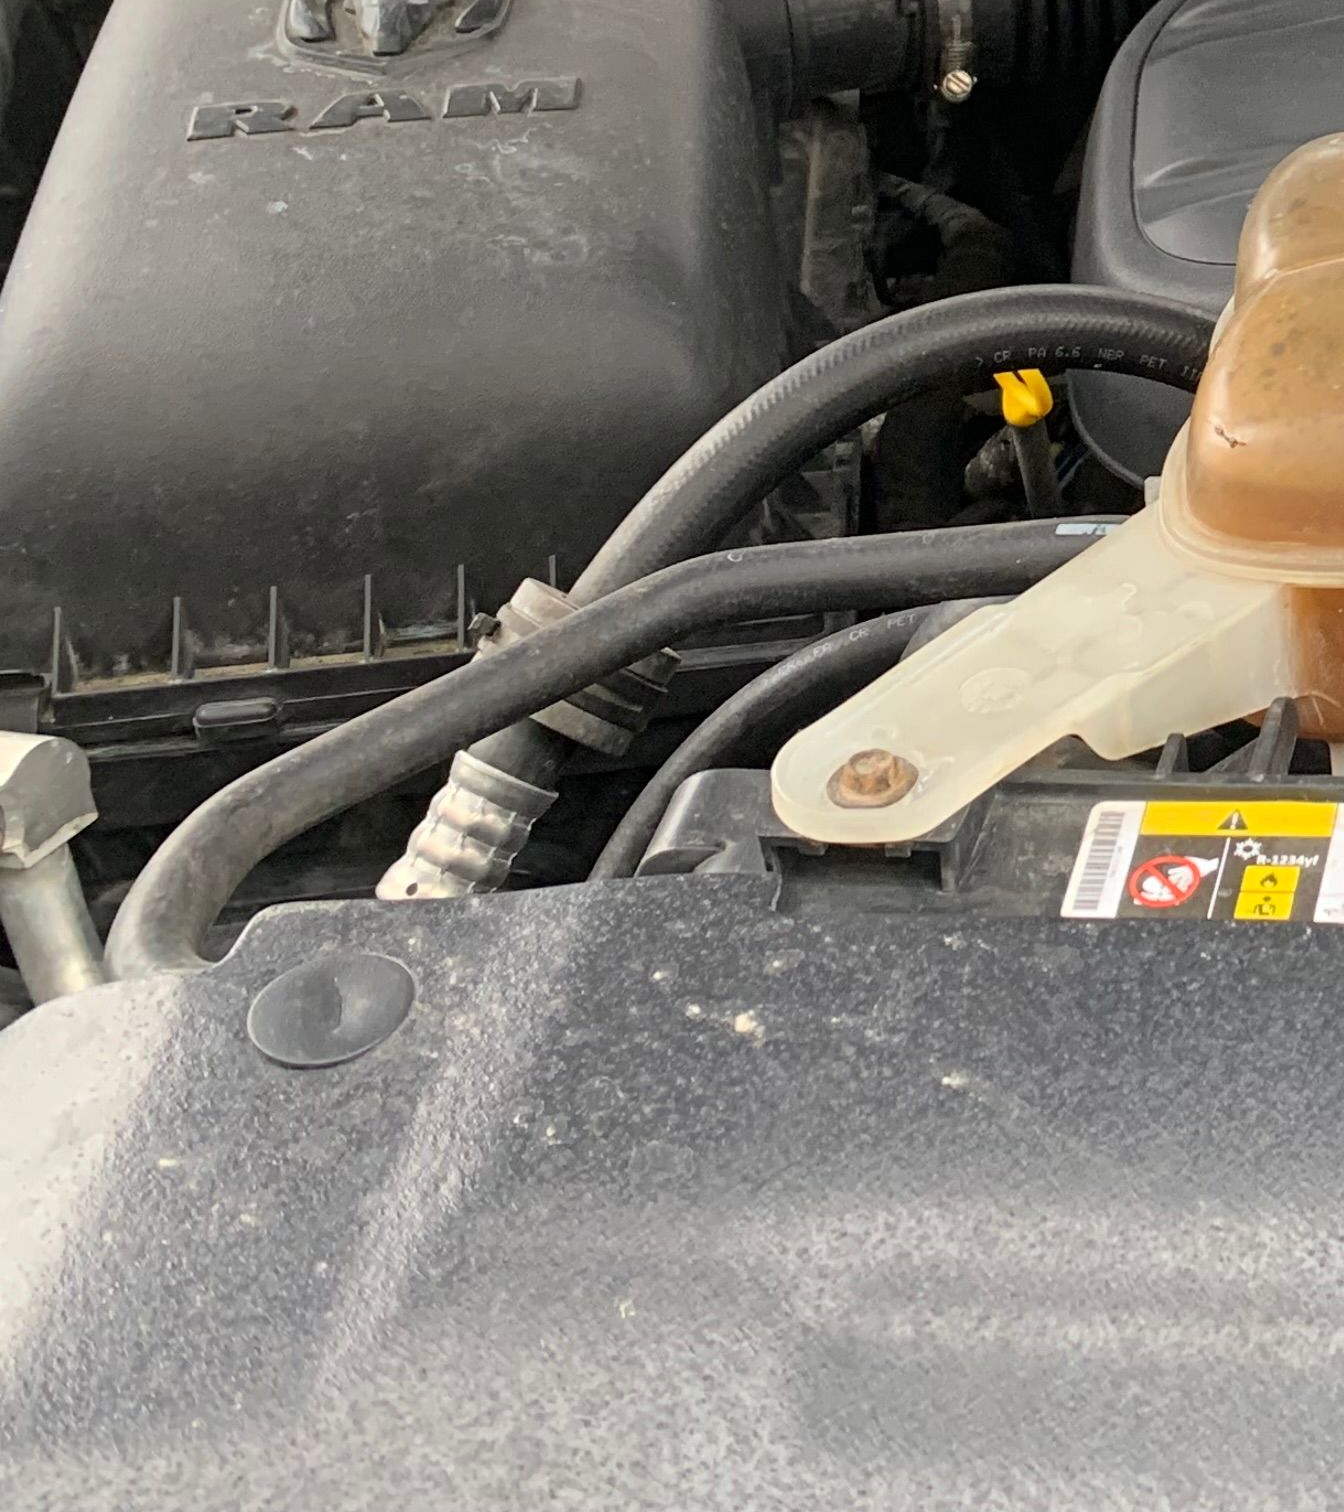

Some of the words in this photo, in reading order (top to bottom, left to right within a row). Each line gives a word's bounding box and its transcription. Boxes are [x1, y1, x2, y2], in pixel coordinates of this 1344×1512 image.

[186, 77, 583, 141] RAM
[1139, 354, 1168, 370] PET
[1256, 854, 1320, 868] R-1234yf
